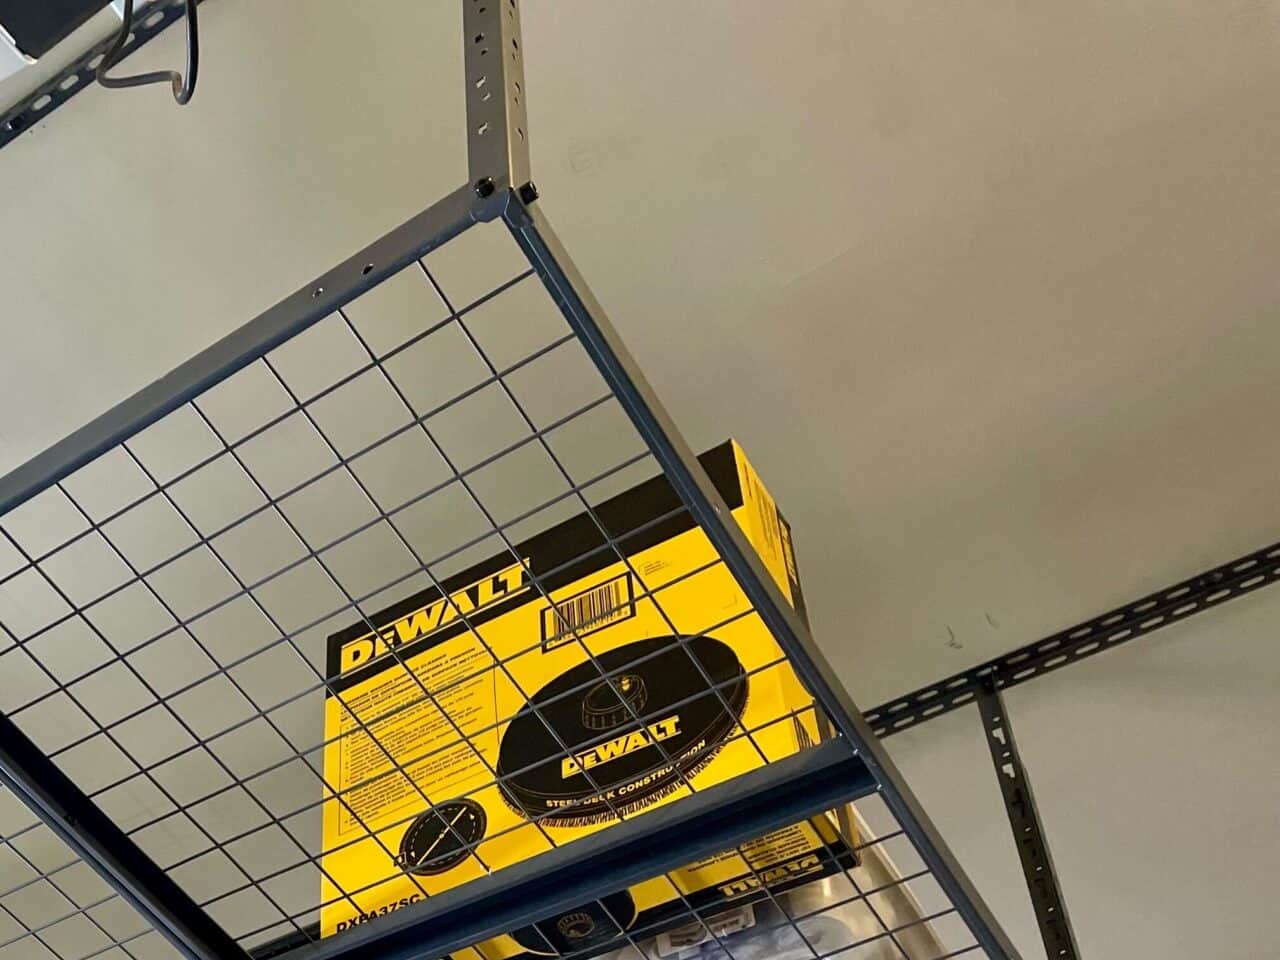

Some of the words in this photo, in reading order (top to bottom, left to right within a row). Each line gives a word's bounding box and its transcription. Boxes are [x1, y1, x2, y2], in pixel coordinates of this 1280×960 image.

[340, 557, 531, 679] DEWALT
[561, 715, 682, 779] DEWALT
[620, 739, 706, 795] CONSTRUION
